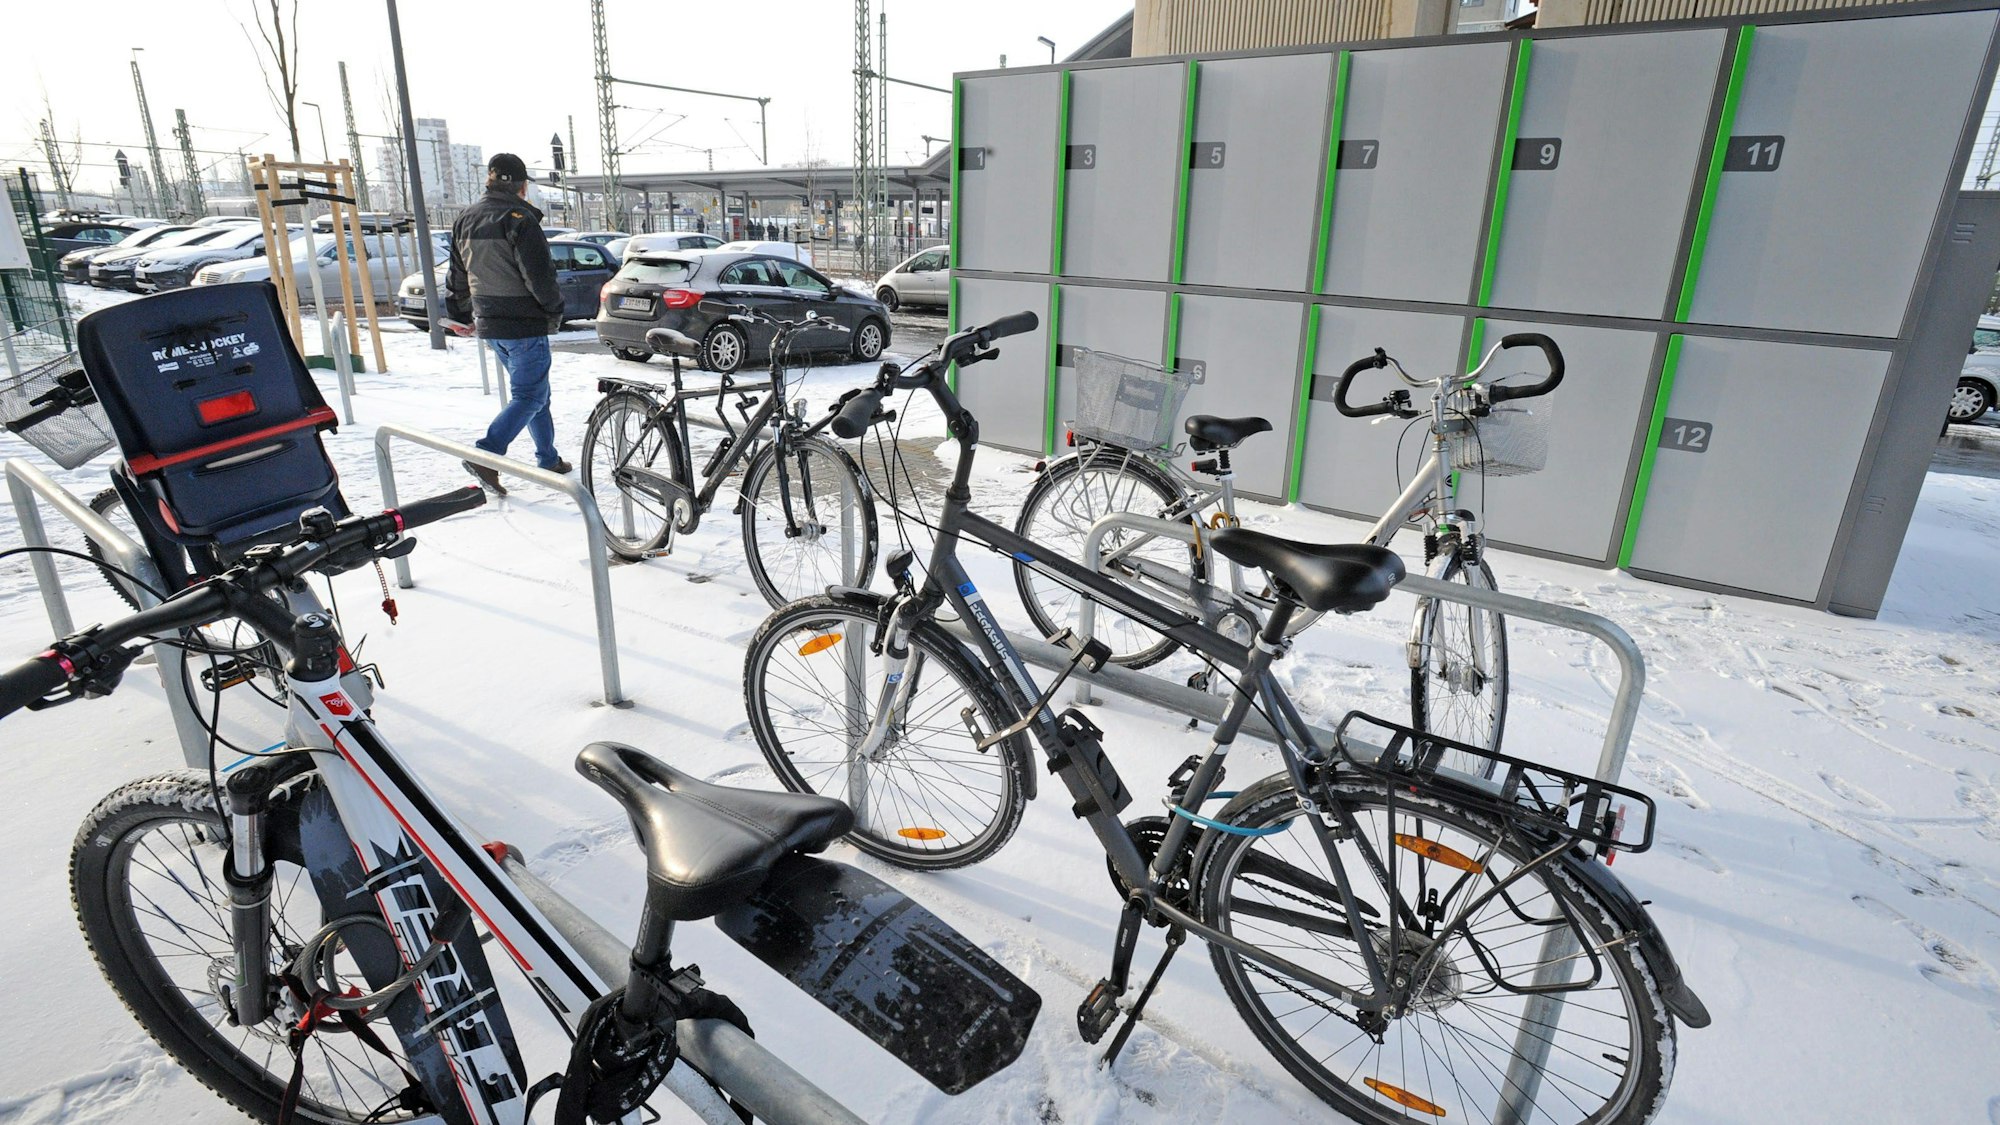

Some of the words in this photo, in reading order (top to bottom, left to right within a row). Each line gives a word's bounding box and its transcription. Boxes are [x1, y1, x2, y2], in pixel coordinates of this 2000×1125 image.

[977, 151, 984, 166] 1
[1084, 149, 1093, 165] 3
[1211, 147, 1222, 164] 5
[1362, 145, 1375, 164] 7
[1540, 143, 1556, 165] 9
[1747, 142, 1779, 166] 11
[1674, 425, 1706, 448] 12
[969, 602, 1011, 660] PEGASUS
